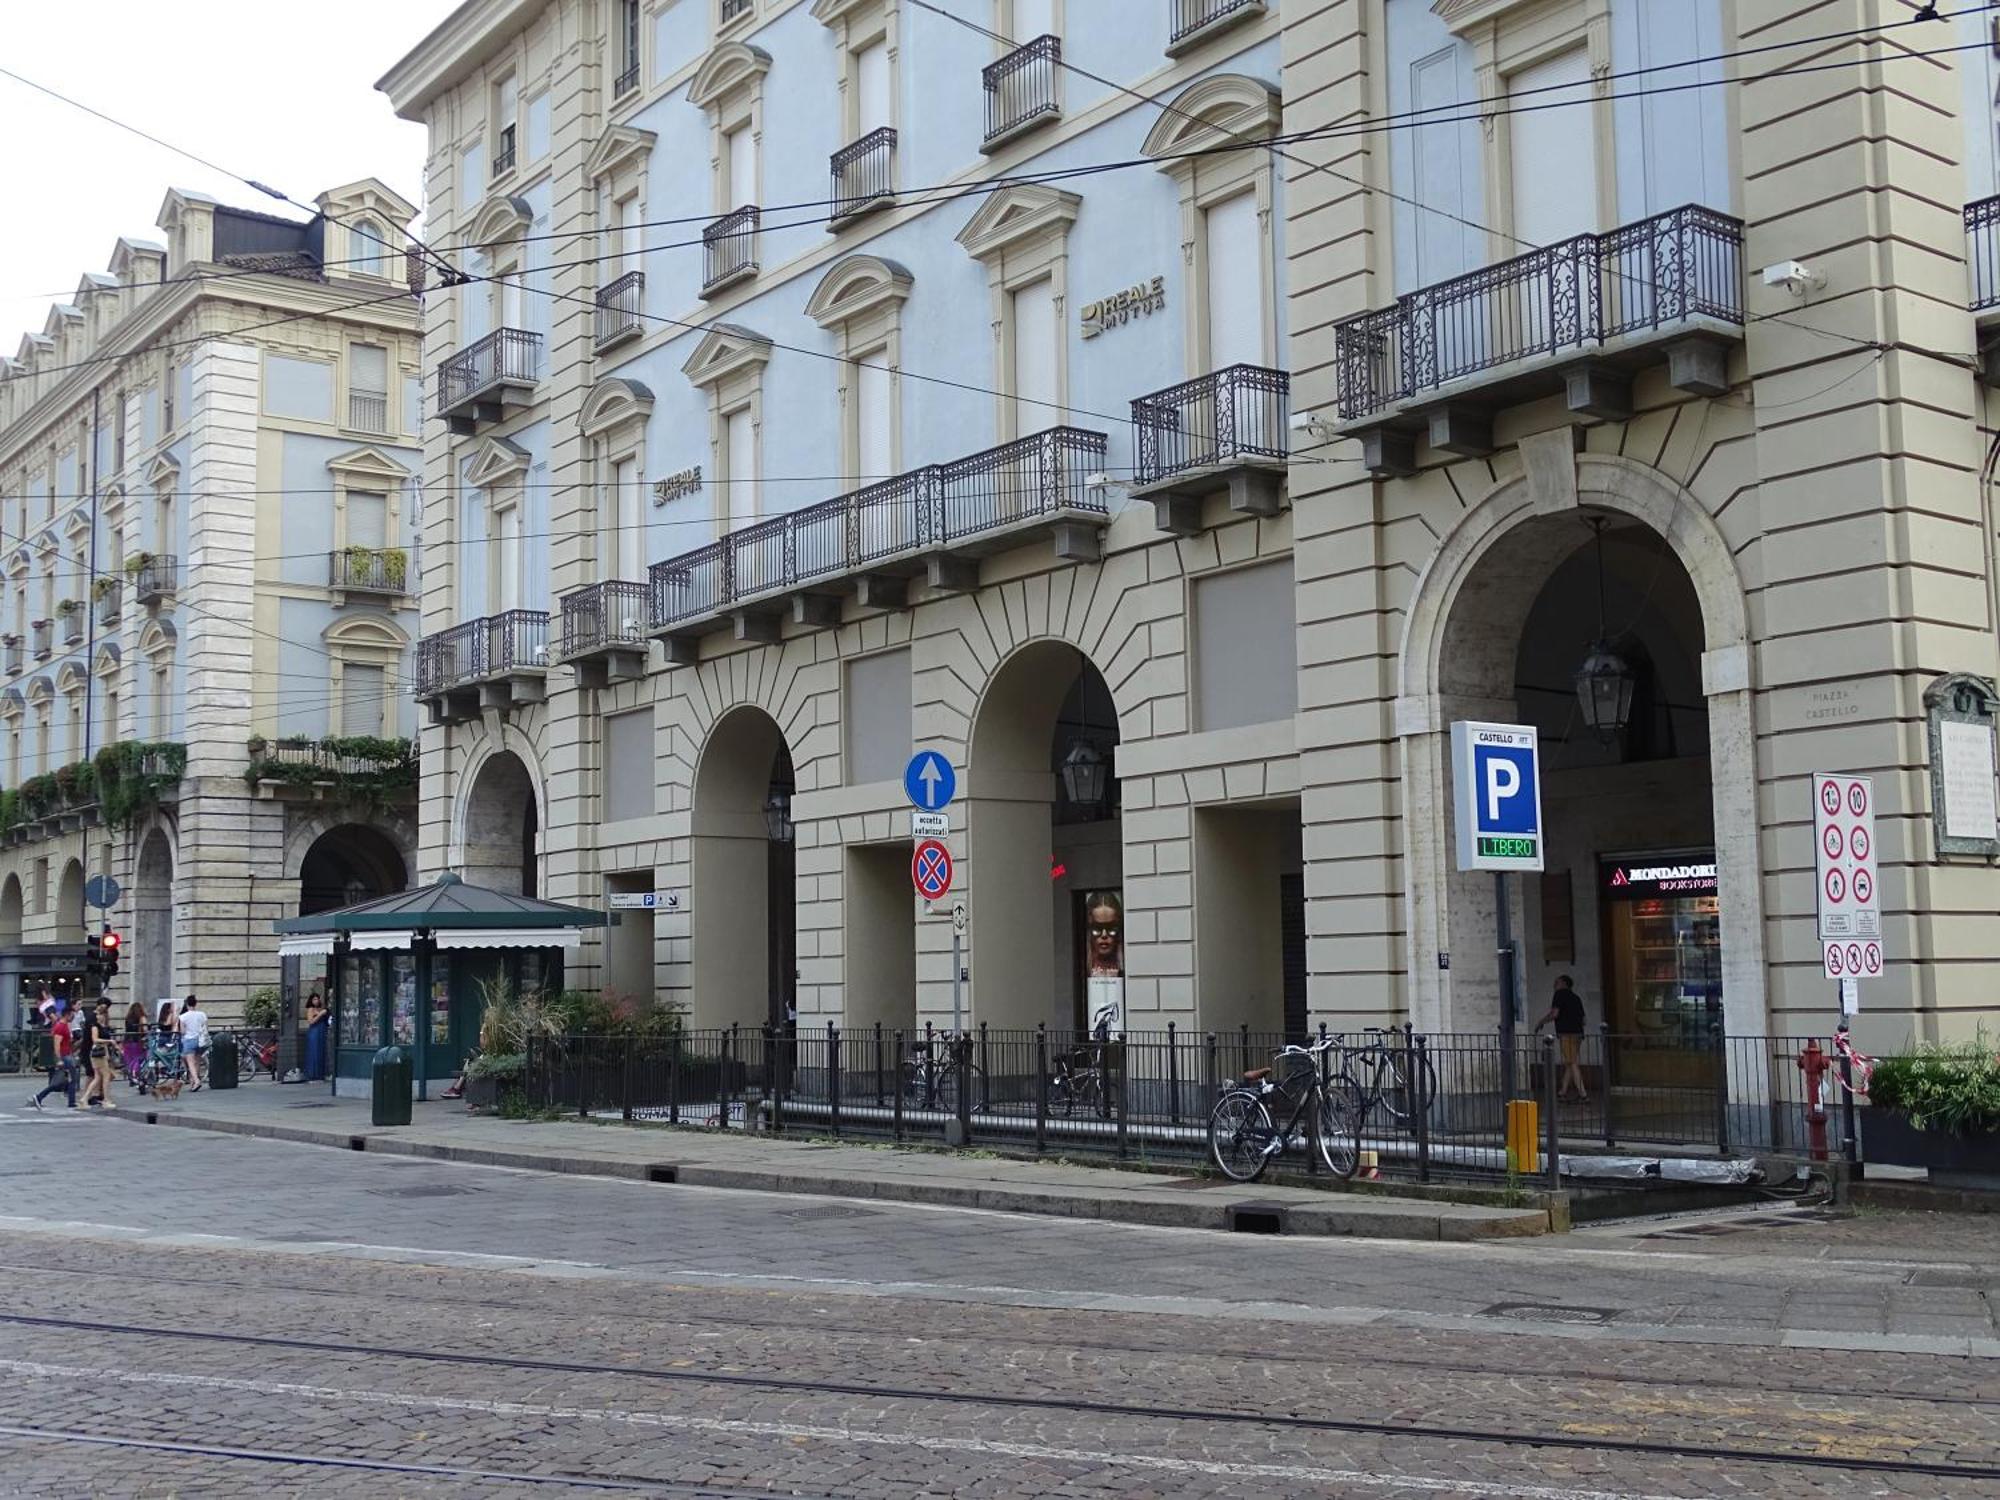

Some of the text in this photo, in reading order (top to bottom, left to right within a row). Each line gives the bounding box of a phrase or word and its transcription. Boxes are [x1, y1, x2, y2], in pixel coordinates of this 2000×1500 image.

[1104, 275, 1164, 315] REALE
[1104, 296, 1165, 330] MUTUA
[666, 465, 702, 489] REALE
[666, 481, 702, 501] MUTUA
[1813, 691, 1848, 701] PIAZZA
[1806, 705, 1858, 719] CASTELLO
[1479, 732, 1513, 744] CASTELLO
[1486, 757, 1520, 820] P
[1482, 838, 1532, 856] LIBERO
[1629, 864, 1717, 881] MONDADORI
